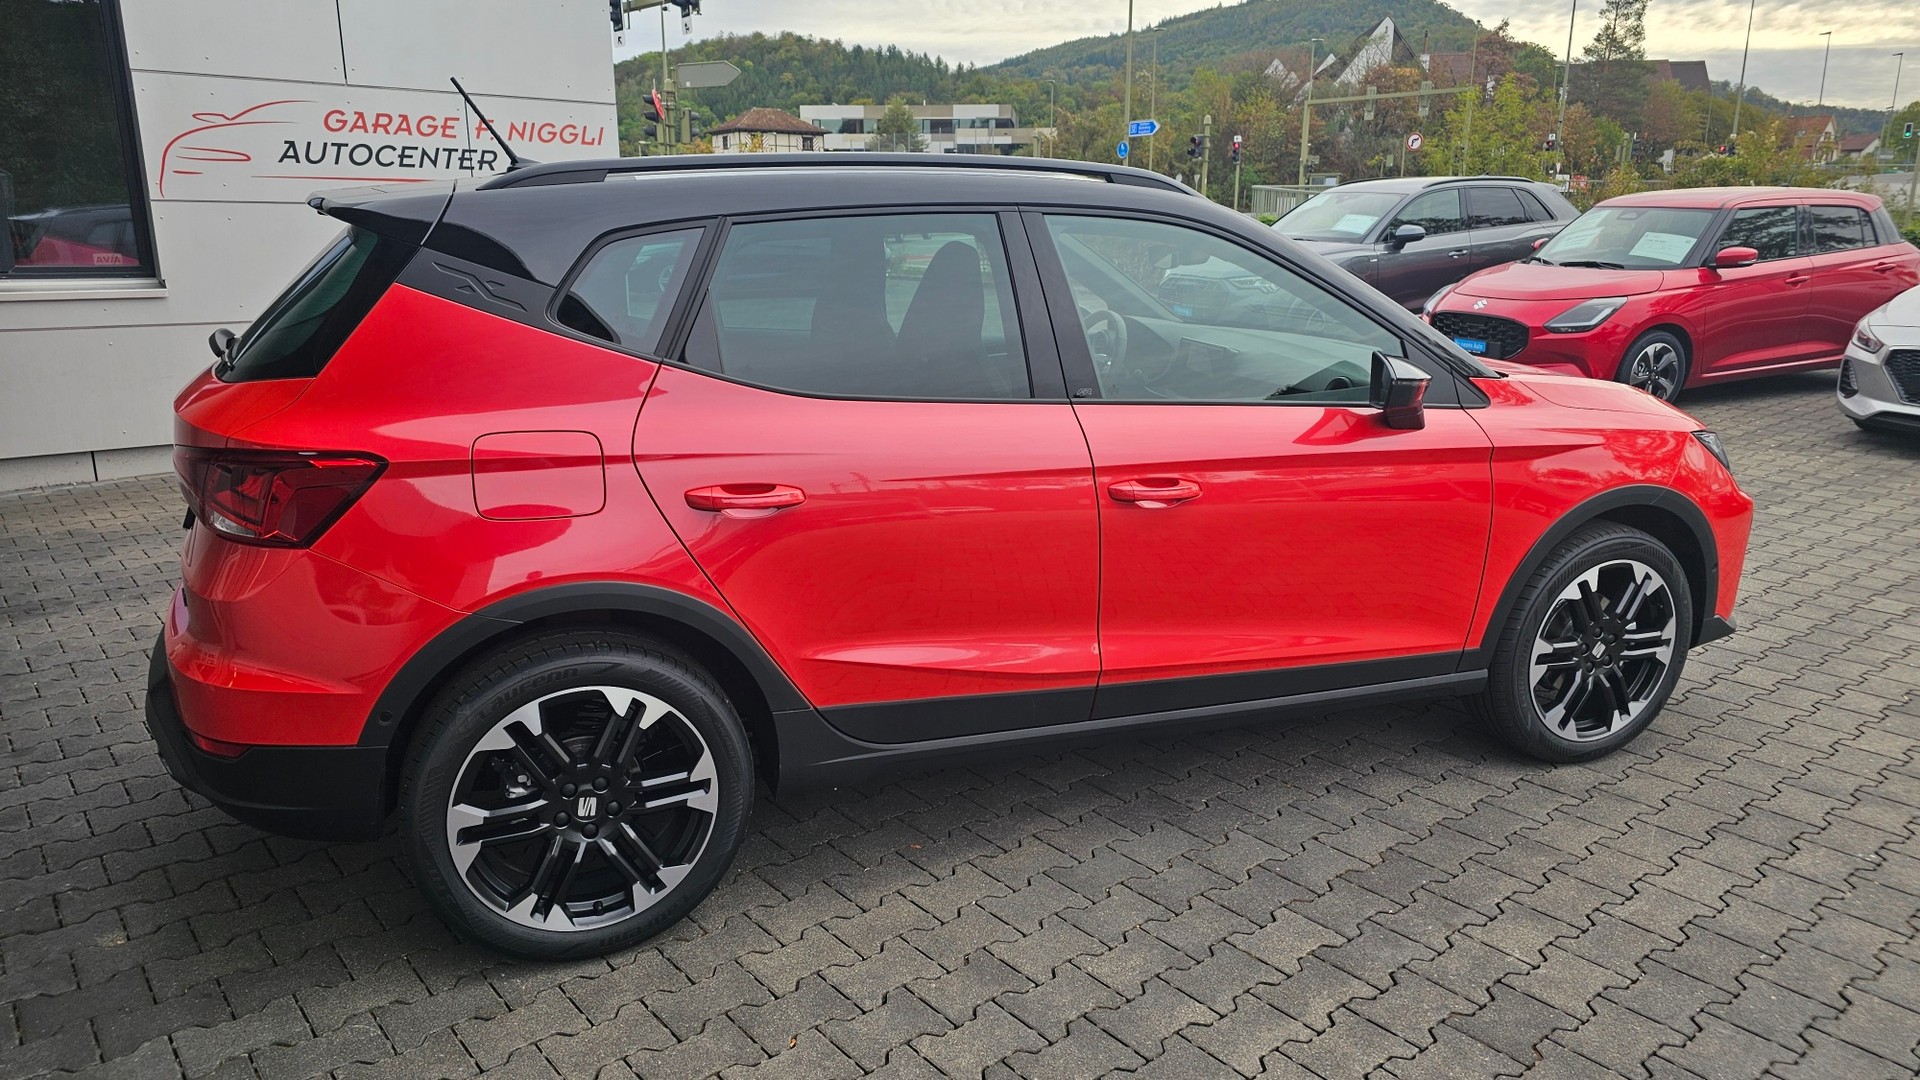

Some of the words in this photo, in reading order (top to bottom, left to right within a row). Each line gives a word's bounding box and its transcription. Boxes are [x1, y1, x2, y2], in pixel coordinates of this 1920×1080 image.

[323, 109, 460, 138] GARAGE
[475, 119, 495, 140] F.
[507, 121, 604, 146] NIGGLI
[278, 140, 498, 171] AUTOCENTER
